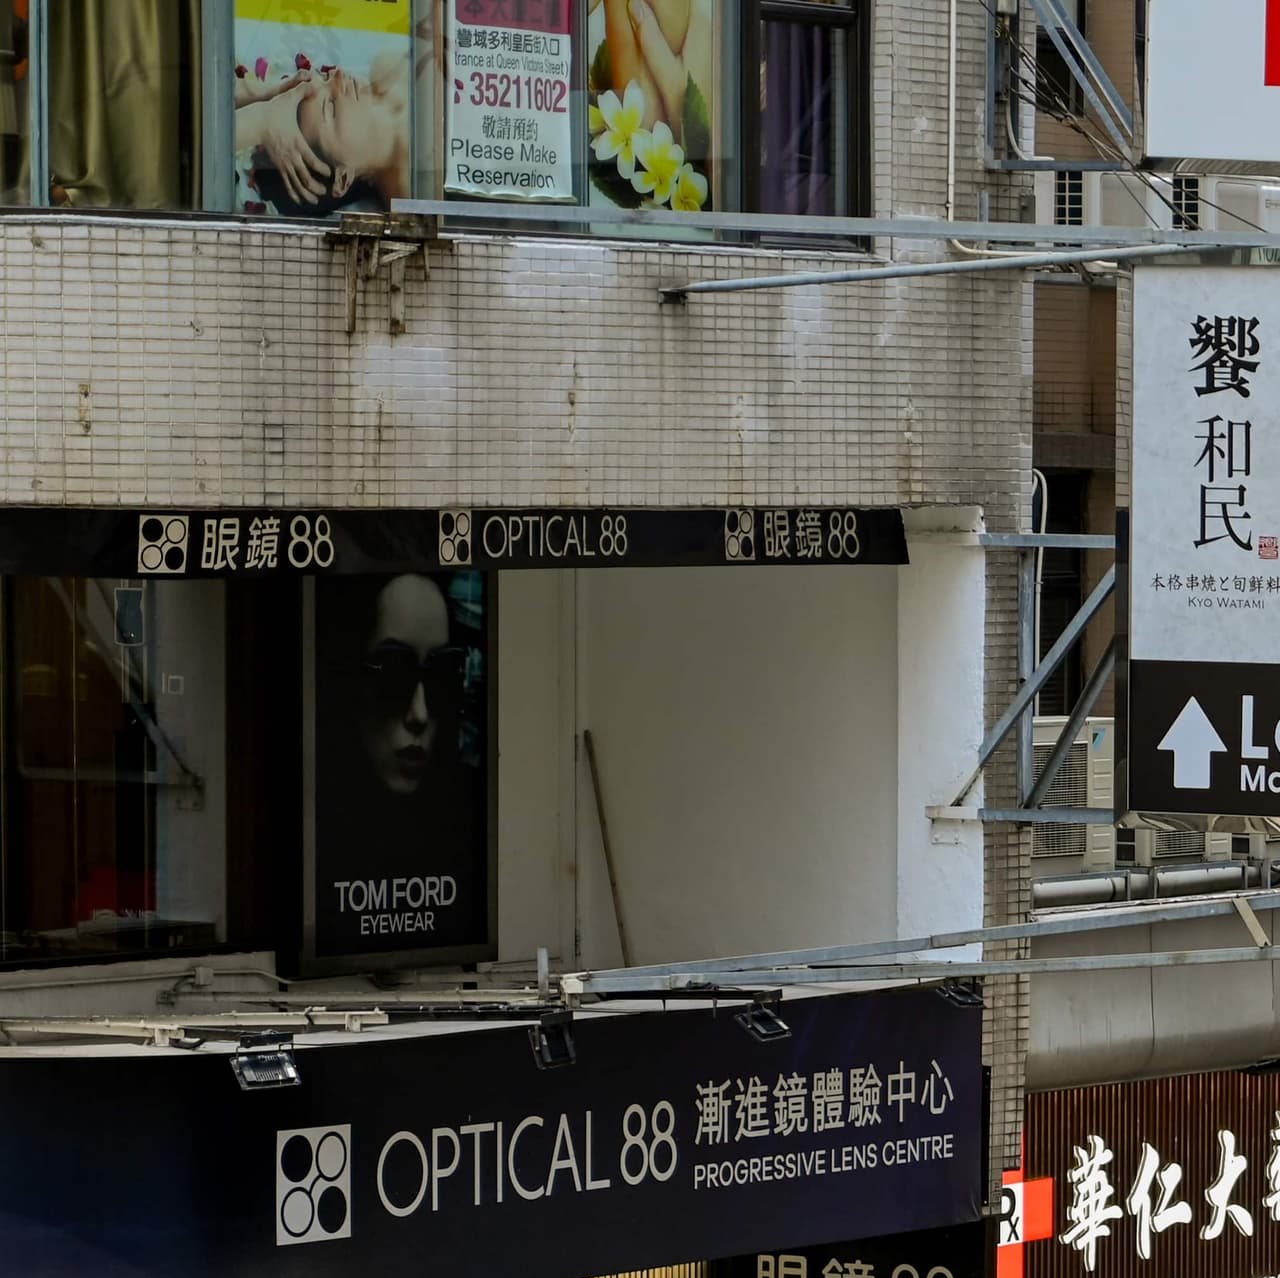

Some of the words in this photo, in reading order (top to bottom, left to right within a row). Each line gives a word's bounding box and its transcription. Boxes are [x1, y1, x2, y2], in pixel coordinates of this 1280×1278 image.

[456, 28, 560, 56] 彎域多利皇后街入口
[455, 51, 484, 67] trance
[486, 55, 495, 67] at
[496, 54, 520, 71] Queen
[522, 56, 544, 73] Victoria
[470, 71, 567, 113] 35211602
[482, 115, 538, 142] 敬請預約
[451, 139, 514, 160] Please
[521, 144, 557, 165] Make
[457, 164, 555, 189] Reservation
[1188, 315, 1260, 551] 饗和民
[483, 517, 595, 560] OPTICAL
[599, 515, 627, 557] 88
[335, 880, 388, 912] TOM
[392, 876, 456, 908] FORD
[360, 913, 434, 936] EYEWEAR
[695, 1058, 955, 1148] 漸進鏡體驗中心
[377, 1111, 610, 1217] OPTICAL
[622, 1101, 677, 1183] 88
[694, 1150, 826, 1190] PROGRESSIVE
[830, 1143, 877, 1173] LENS
[883, 1134, 954, 1167] CENTRE
